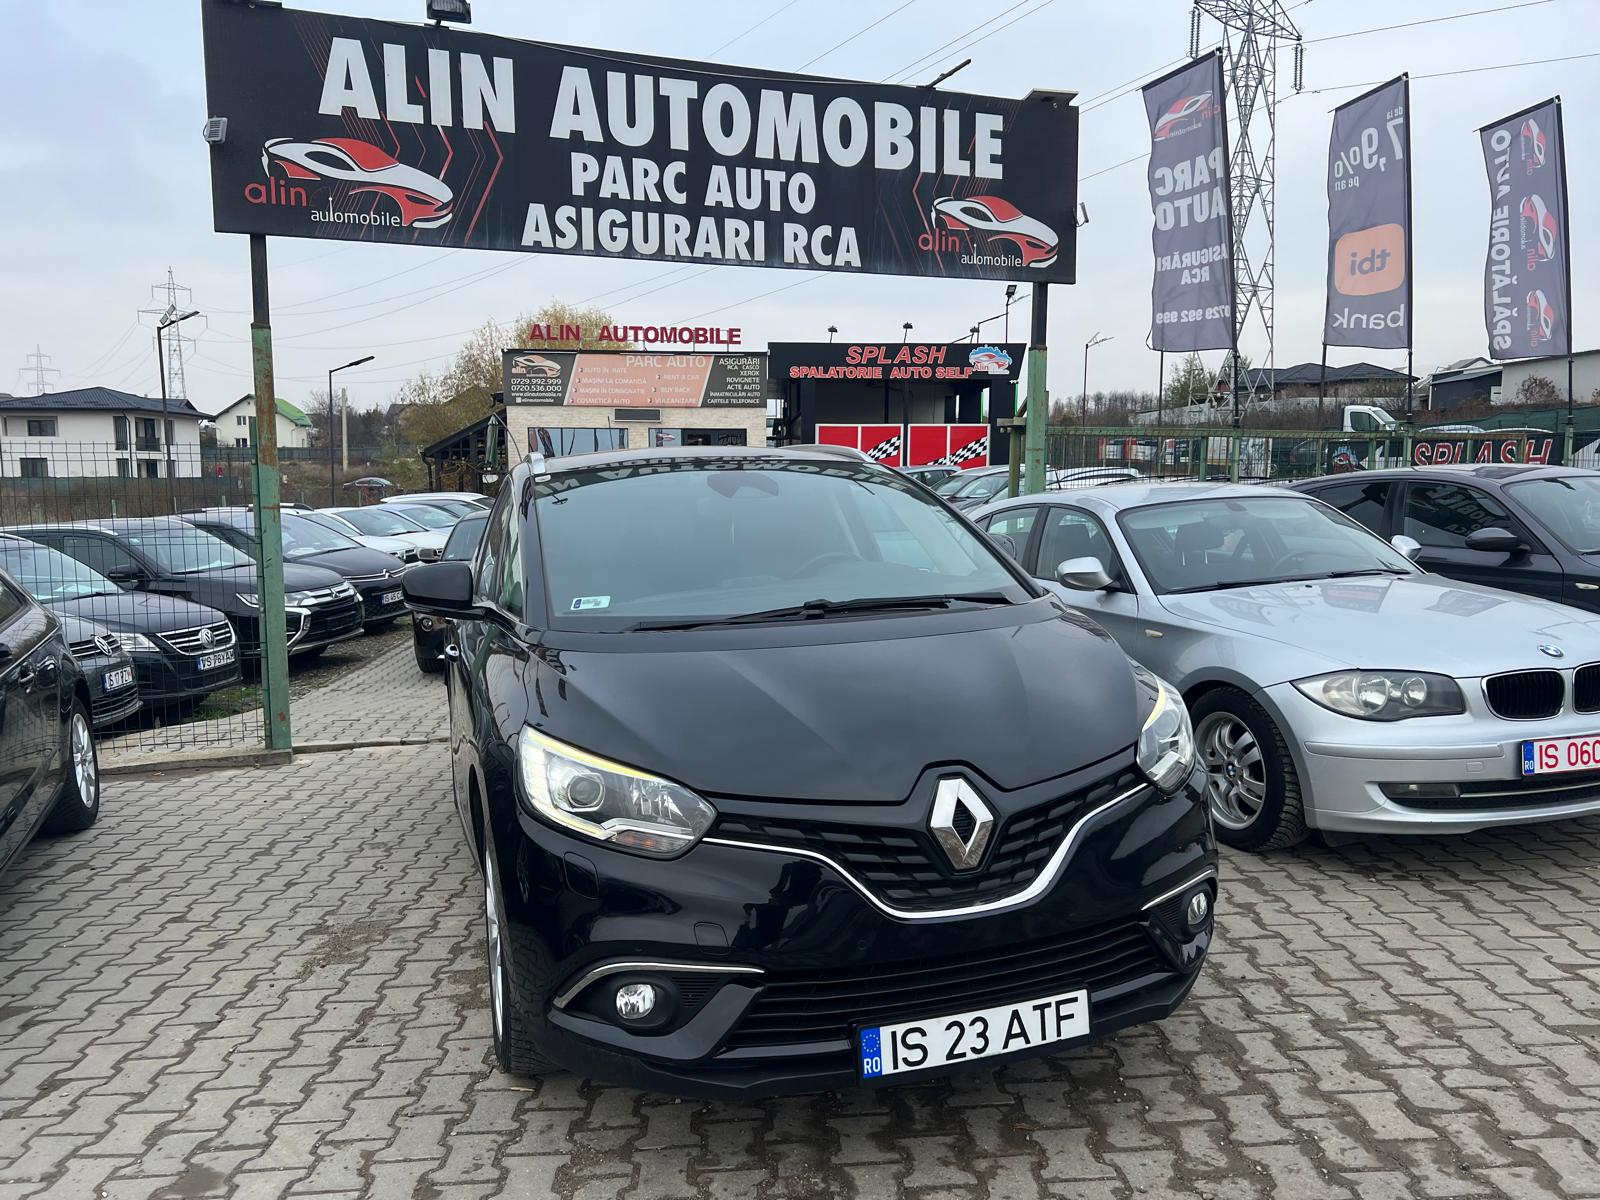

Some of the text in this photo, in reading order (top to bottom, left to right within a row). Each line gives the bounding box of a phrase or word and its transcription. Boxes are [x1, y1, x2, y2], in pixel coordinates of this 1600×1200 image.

[318, 36, 1004, 179] ALIN AUTOMOBILE
[243, 176, 308, 207] alin
[570, 151, 816, 214] PARC AUTO
[520, 202, 862, 268] ASIGURARI RCA
[918, 227, 960, 252] alin
[529, 323, 742, 345] ALIN AUTOMOBILE
[626, 355, 706, 368] PARC AUTO
[845, 345, 947, 364] SPLASH
[789, 366, 972, 379] SPALATORIE AUTO SELF
[1524, 760, 1534, 771] RO
[1538, 743, 1559, 769] IS
[890, 996, 1079, 1070] IS 23 ATF
[863, 1056, 881, 1075] RO
